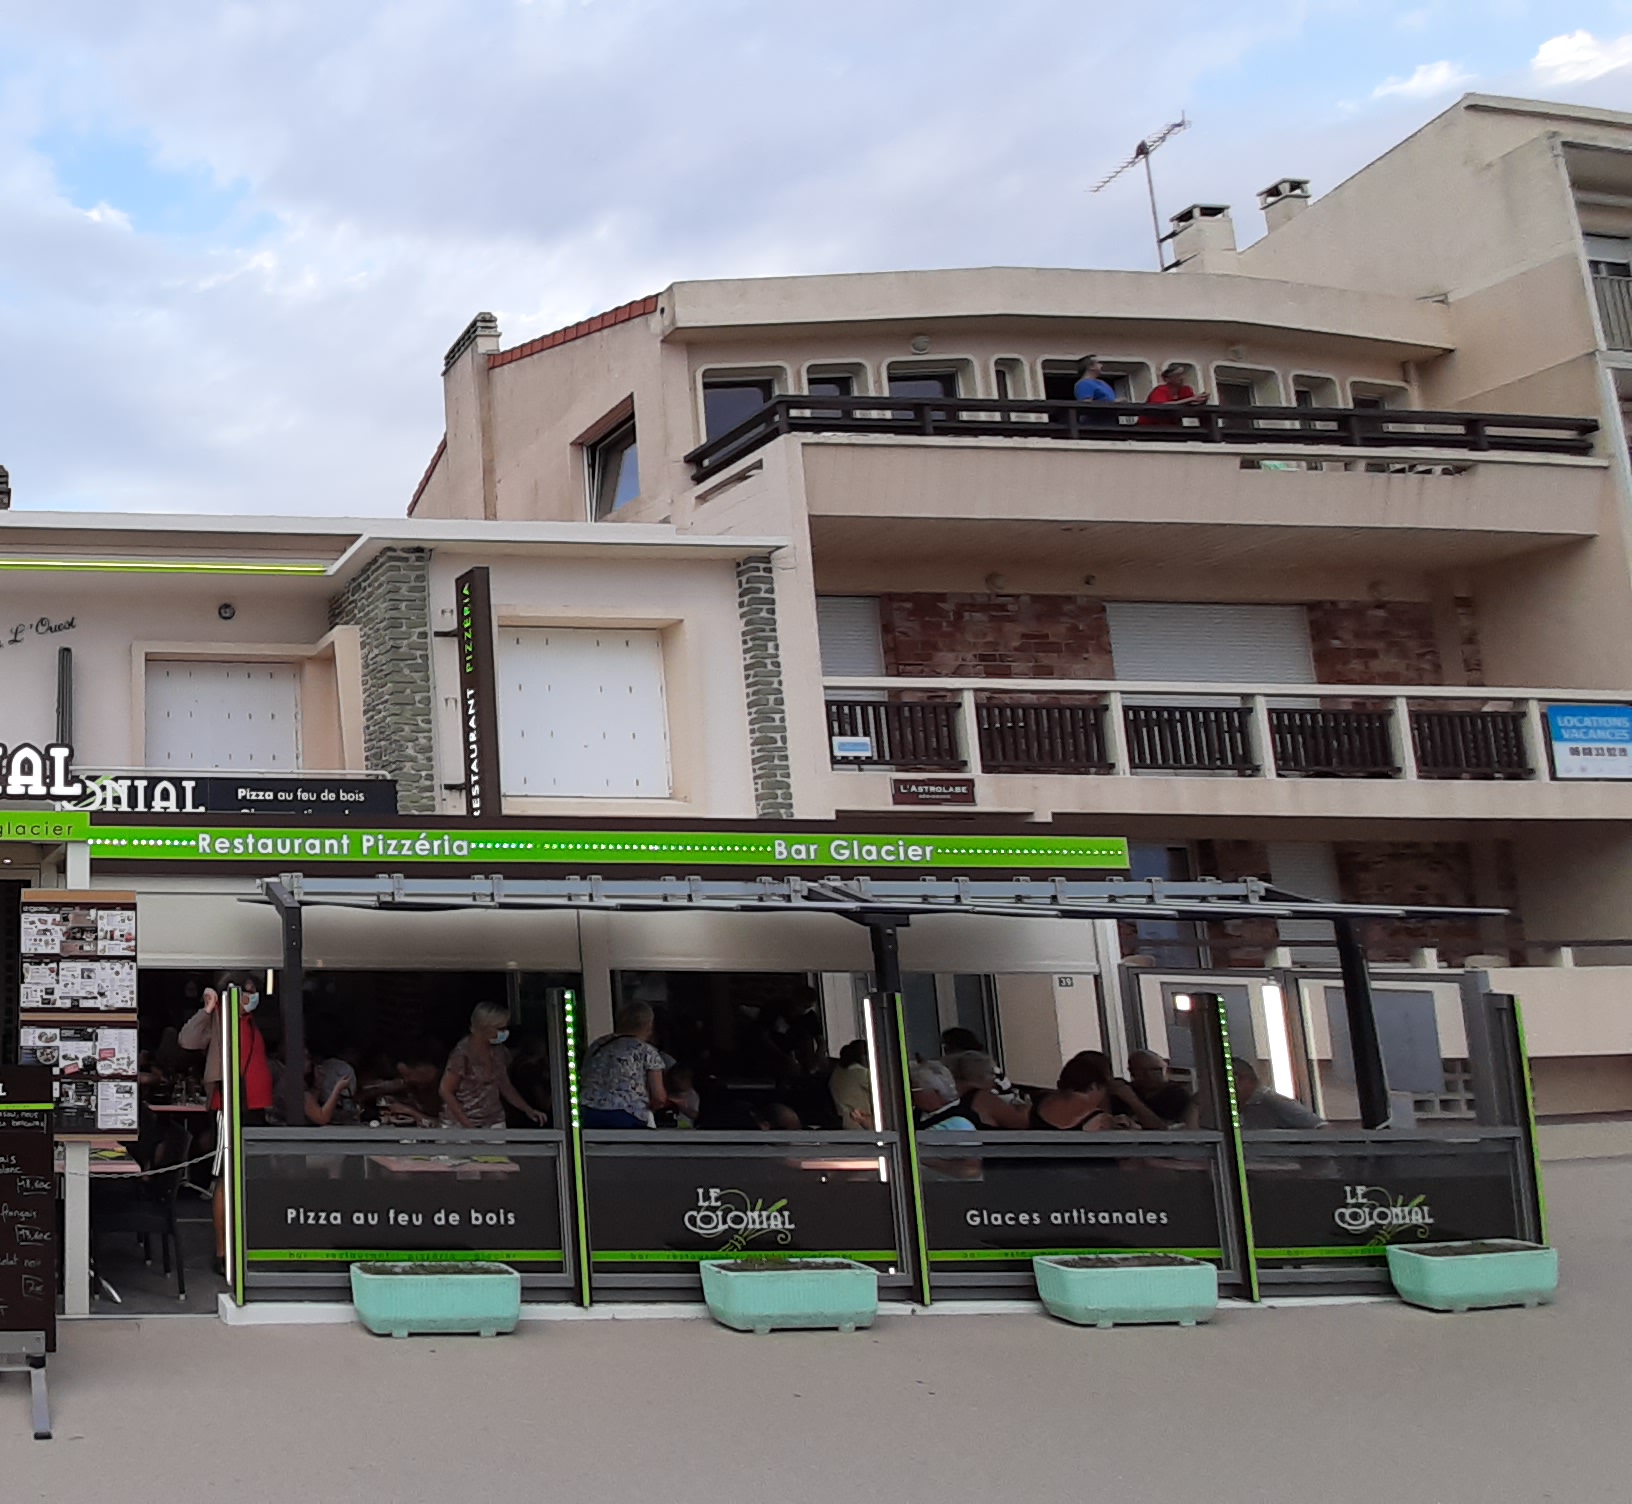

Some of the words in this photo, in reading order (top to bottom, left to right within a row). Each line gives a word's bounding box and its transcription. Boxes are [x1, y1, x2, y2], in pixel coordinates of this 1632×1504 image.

[1556, 715, 1630, 728] LOCATIONS
[1560, 728, 1630, 740] VACANCES
[237, 788, 274, 801] Pizza
[277, 790, 294, 801] au
[297, 788, 319, 801] feu
[320, 788, 336, 801] de
[339, 789, 365, 802] bois
[197, 832, 350, 857] Restaurant
[362, 834, 470, 857] Pizzéria
[774, 839, 818, 861] Bar
[830, 839, 934, 863] Glacier
[697, 1187, 721, 1207] LE
[1344, 1185, 1368, 1204] LE
[0, 1202, 37, 1223] français
[286, 1208, 343, 1226] Pizza
[352, 1211, 379, 1226] au
[388, 1208, 424, 1226] feu
[433, 1208, 461, 1226] de
[470, 1208, 517, 1226] bois
[965, 1209, 1041, 1226] Glaces
[1050, 1207, 1168, 1225] artisanales
[1334, 1205, 1435, 1231] COLONIAL
[683, 1210, 795, 1235] COLONIAL
